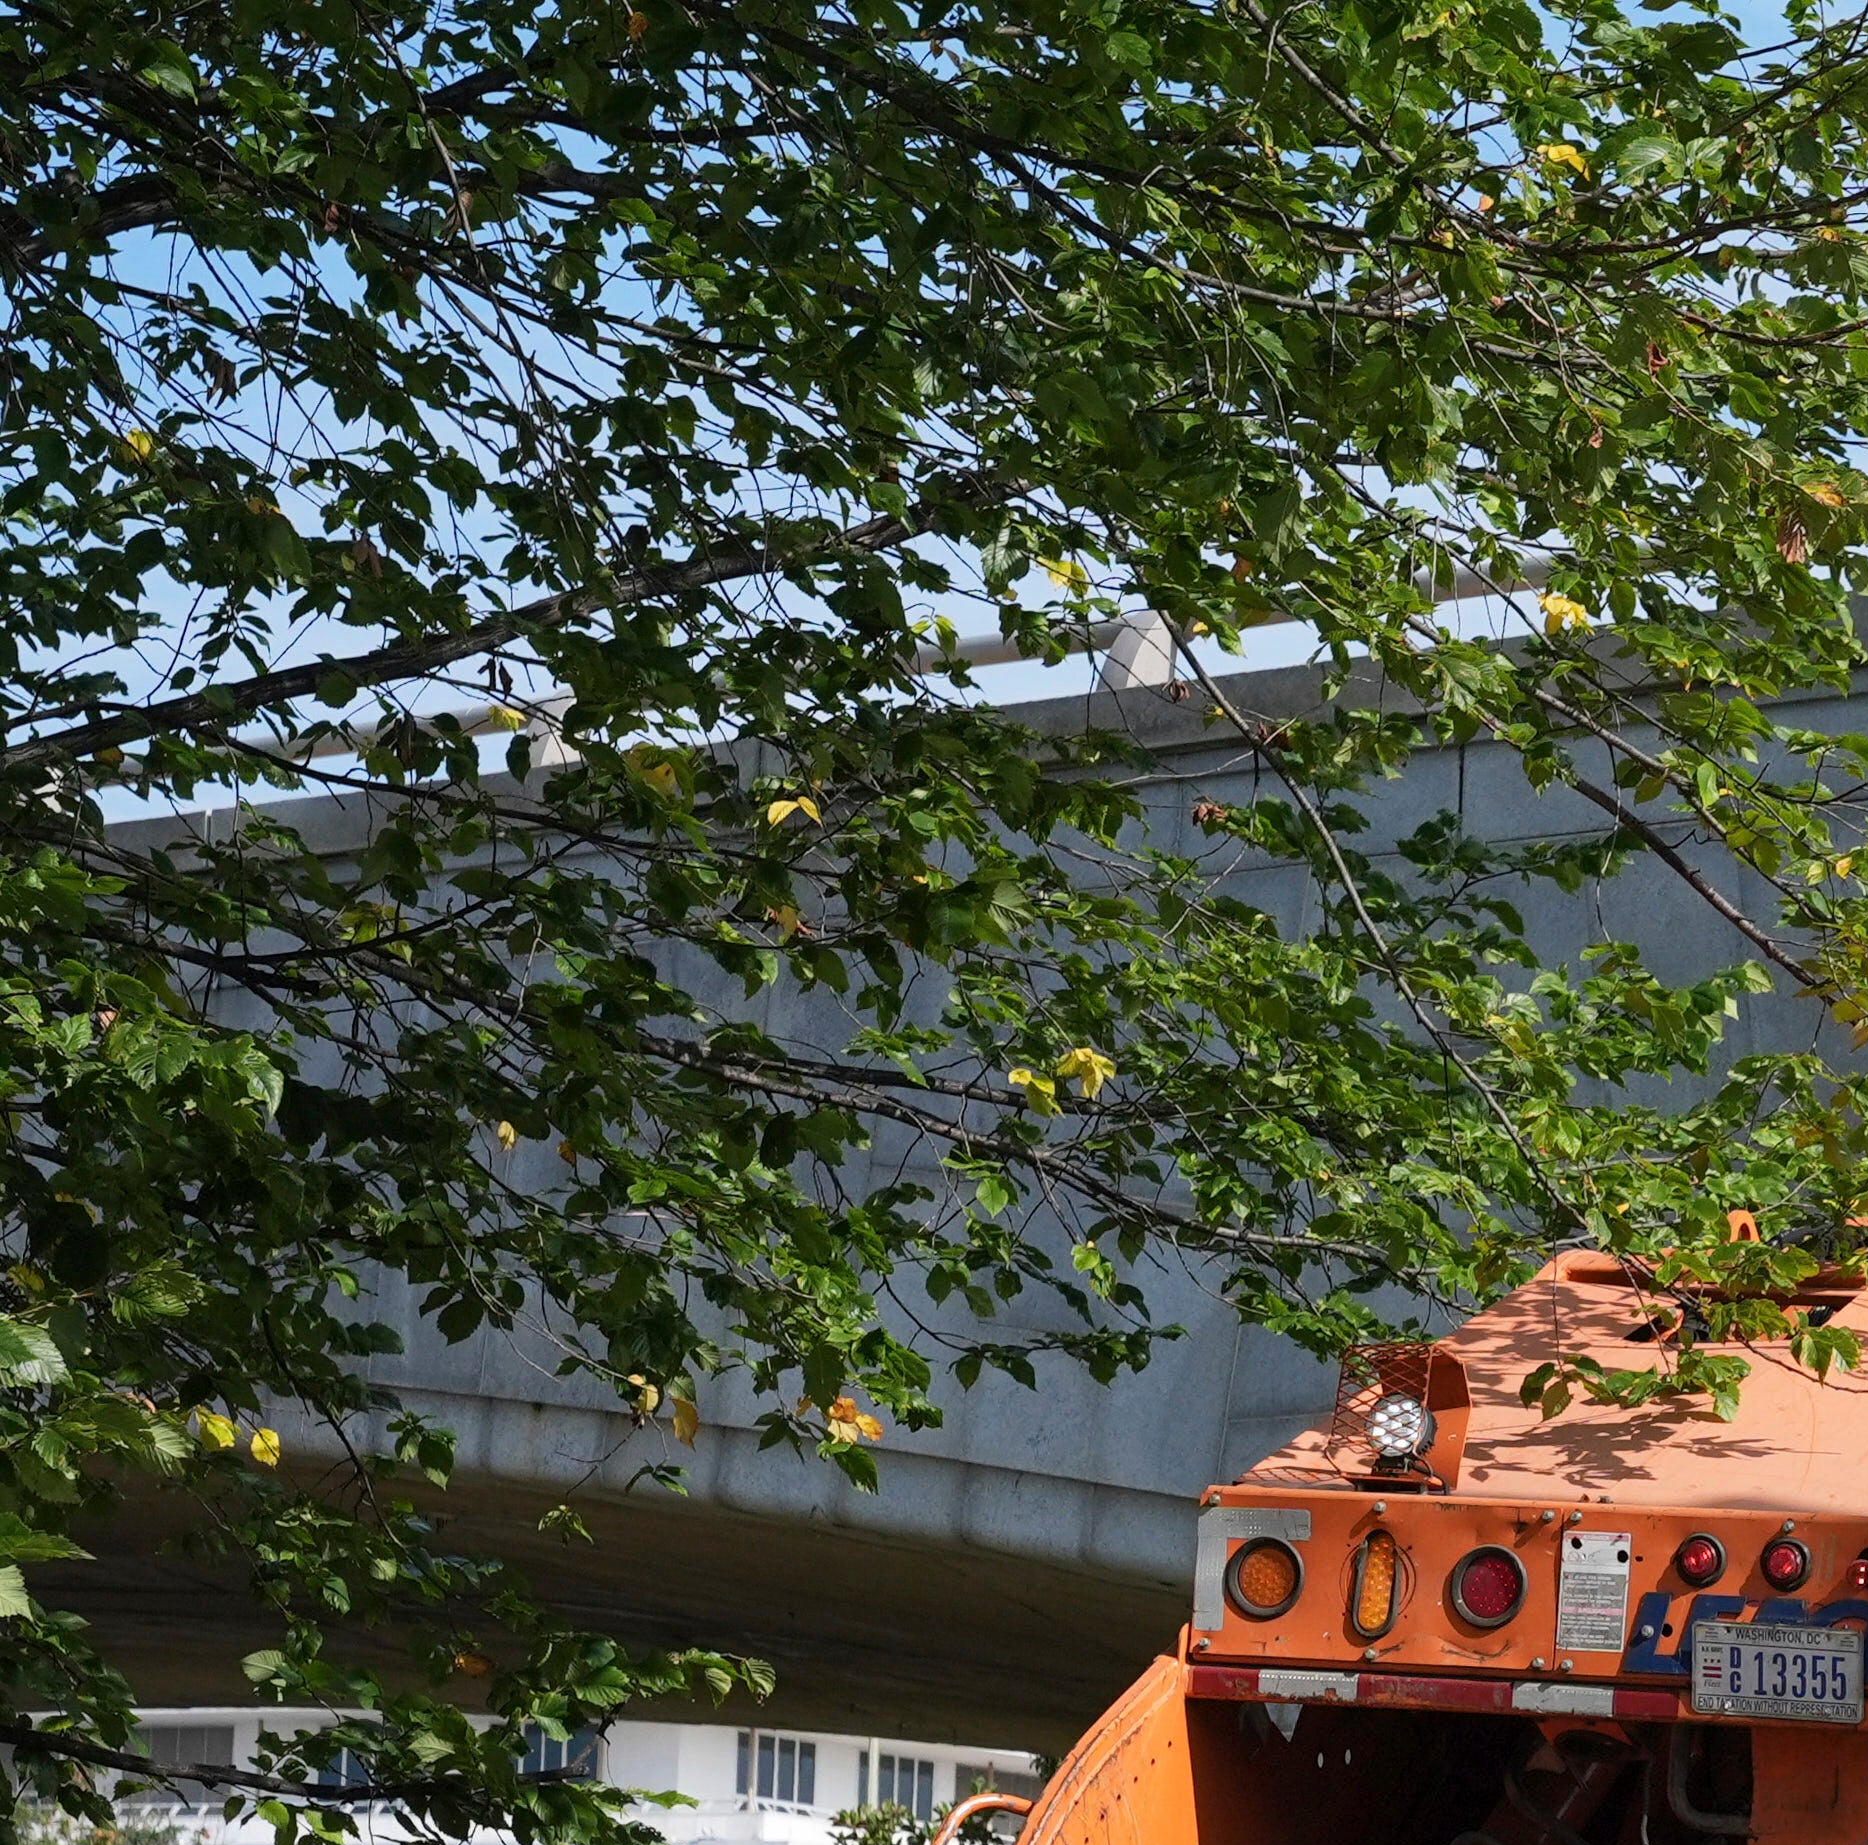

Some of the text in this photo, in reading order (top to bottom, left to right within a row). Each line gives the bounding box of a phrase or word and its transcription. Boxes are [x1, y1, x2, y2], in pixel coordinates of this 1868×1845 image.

[1806, 1633, 1821, 1645] DC
[1753, 1651, 1847, 1701] 13355
[1715, 1698, 1752, 1711] TAATION
[1753, 1699, 1789, 1714] WITHOUT
[1790, 1702, 1858, 1718] REPRESTATION
